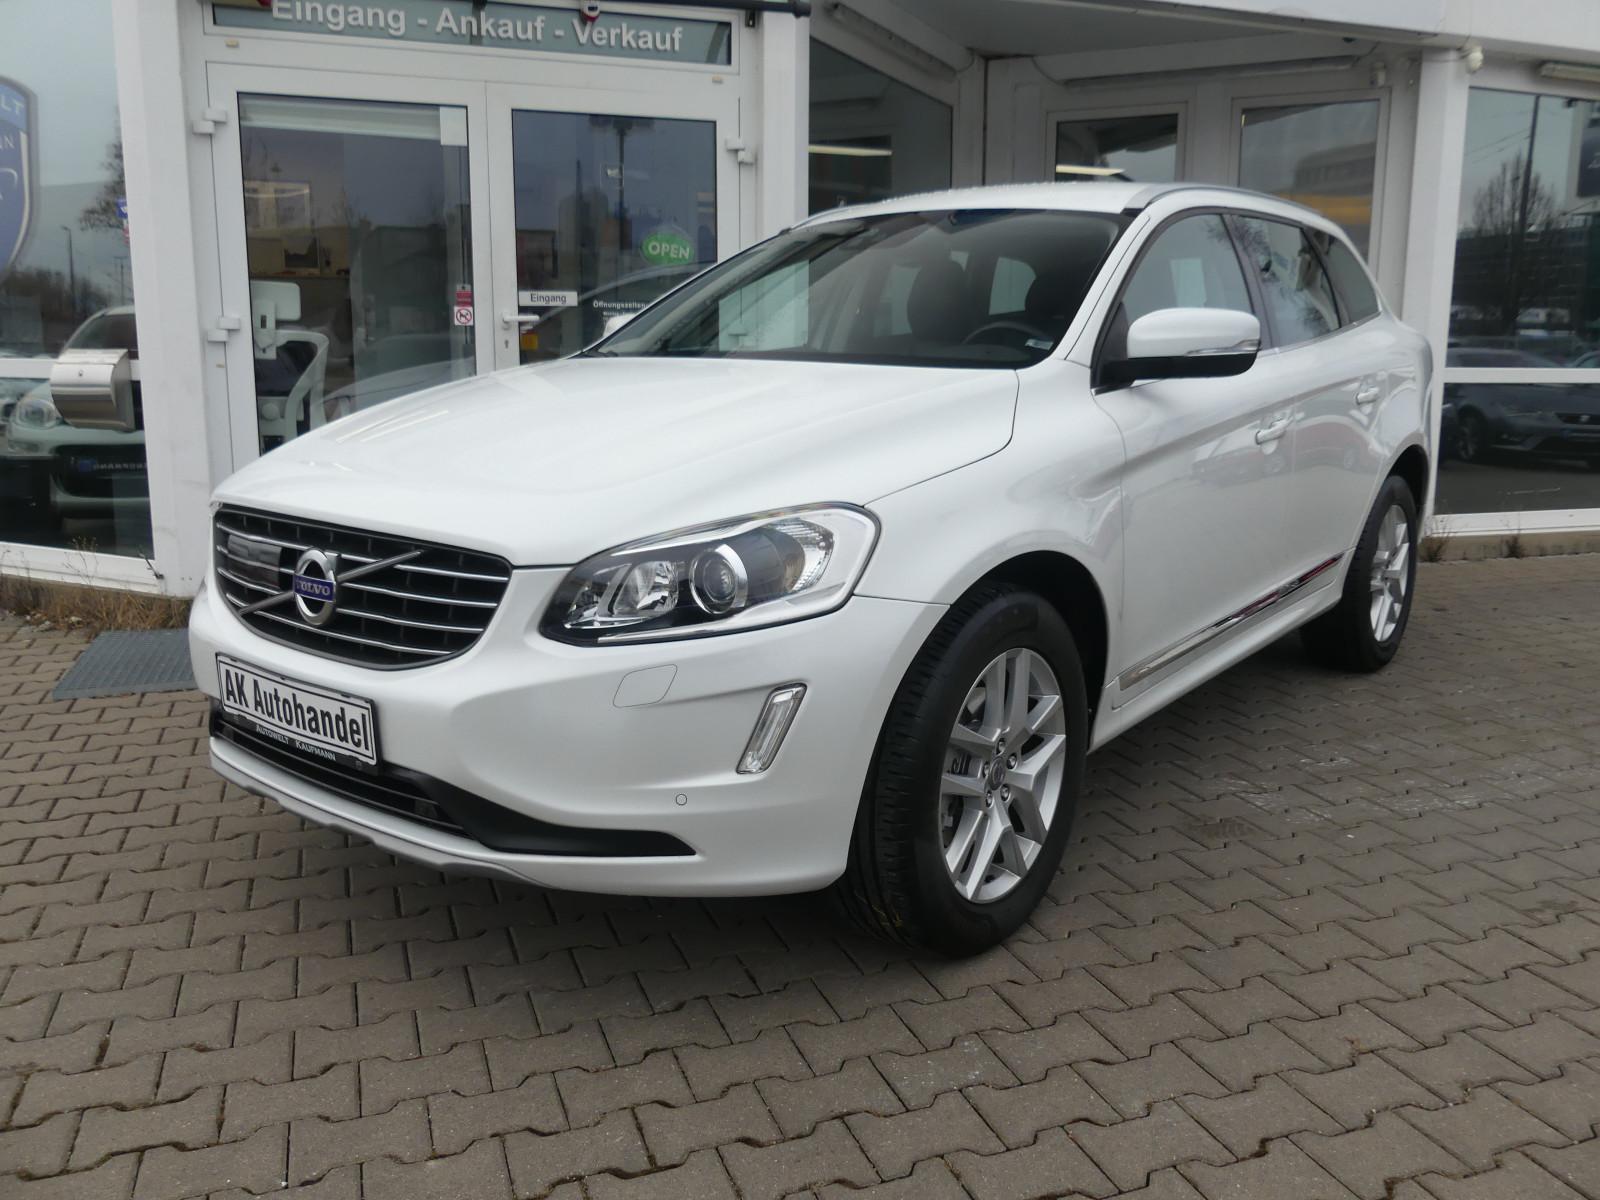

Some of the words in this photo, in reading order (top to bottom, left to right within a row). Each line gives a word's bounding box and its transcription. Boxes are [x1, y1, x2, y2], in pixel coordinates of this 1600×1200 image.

[271, 0, 406, 36] Eingang
[435, 7, 546, 41] Ankauf
[572, 18, 683, 52] Verkauf
[648, 240, 690, 260] OPEN
[530, 292, 567, 306] Eingang
[295, 579, 331, 596] VOLVO
[225, 669, 250, 708] AK
[253, 678, 370, 751] Autohandel
[256, 724, 289, 745] AUTOWELT
[295, 739, 337, 762] KAUFMANN
